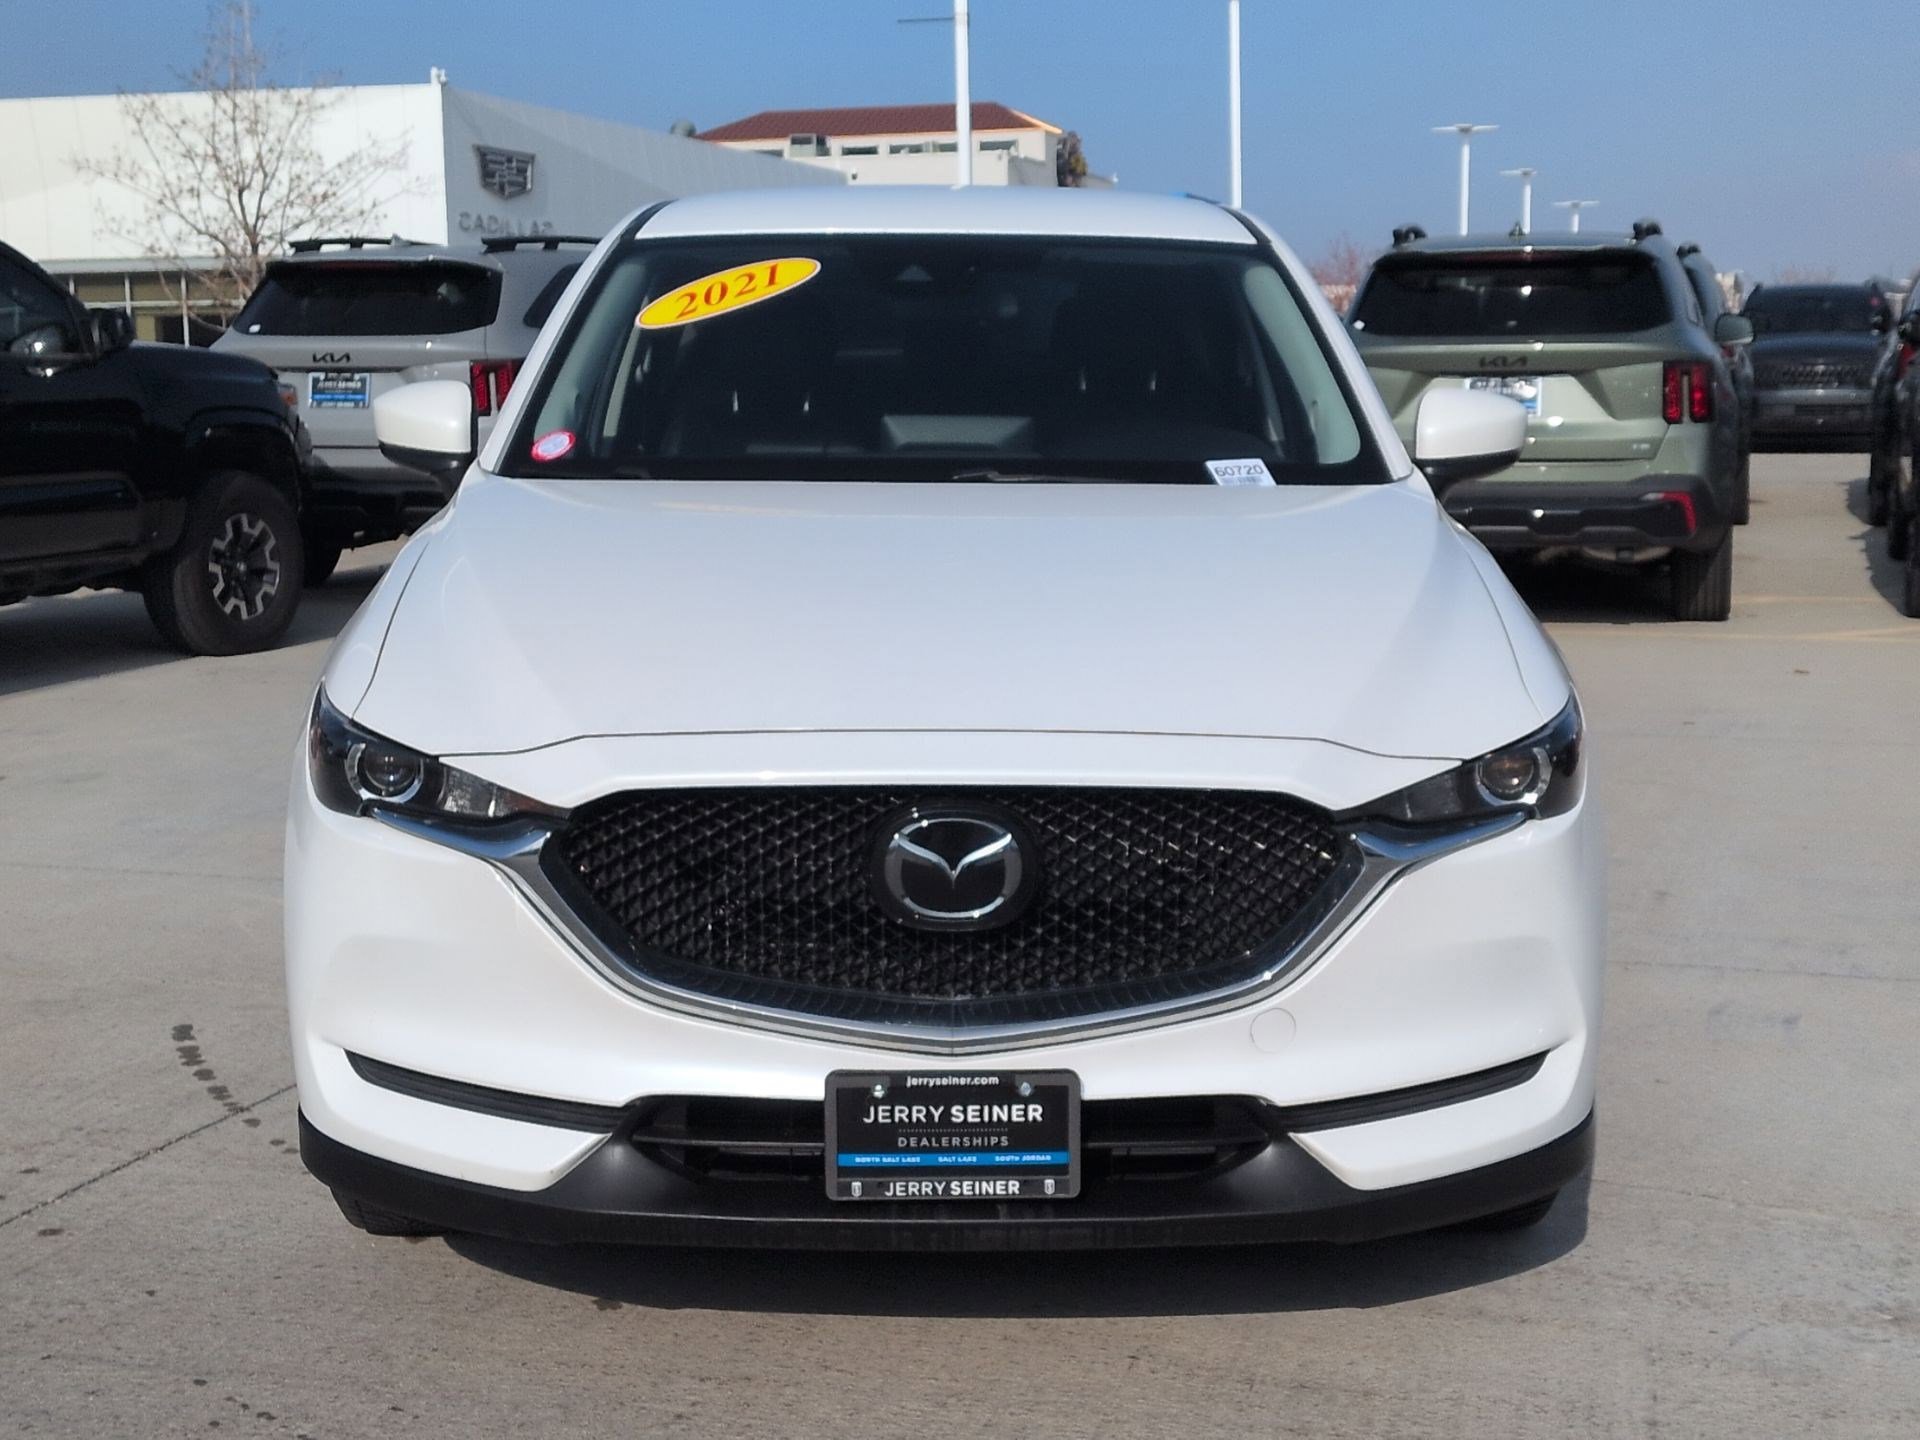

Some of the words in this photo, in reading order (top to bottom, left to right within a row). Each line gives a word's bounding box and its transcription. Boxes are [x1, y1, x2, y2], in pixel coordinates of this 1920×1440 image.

[675, 263, 780, 319] 2021
[312, 352, 351, 363] KIA
[1214, 464, 1264, 477] 60720
[906, 1075, 999, 1088] jerryseiner.com
[863, 1105, 945, 1124] JERRY
[950, 1104, 1044, 1123] SEINER
[897, 1136, 1010, 1148] DEALERSHIPS
[885, 1181, 946, 1197] JERRY
[950, 1180, 1020, 1196] SEINER
